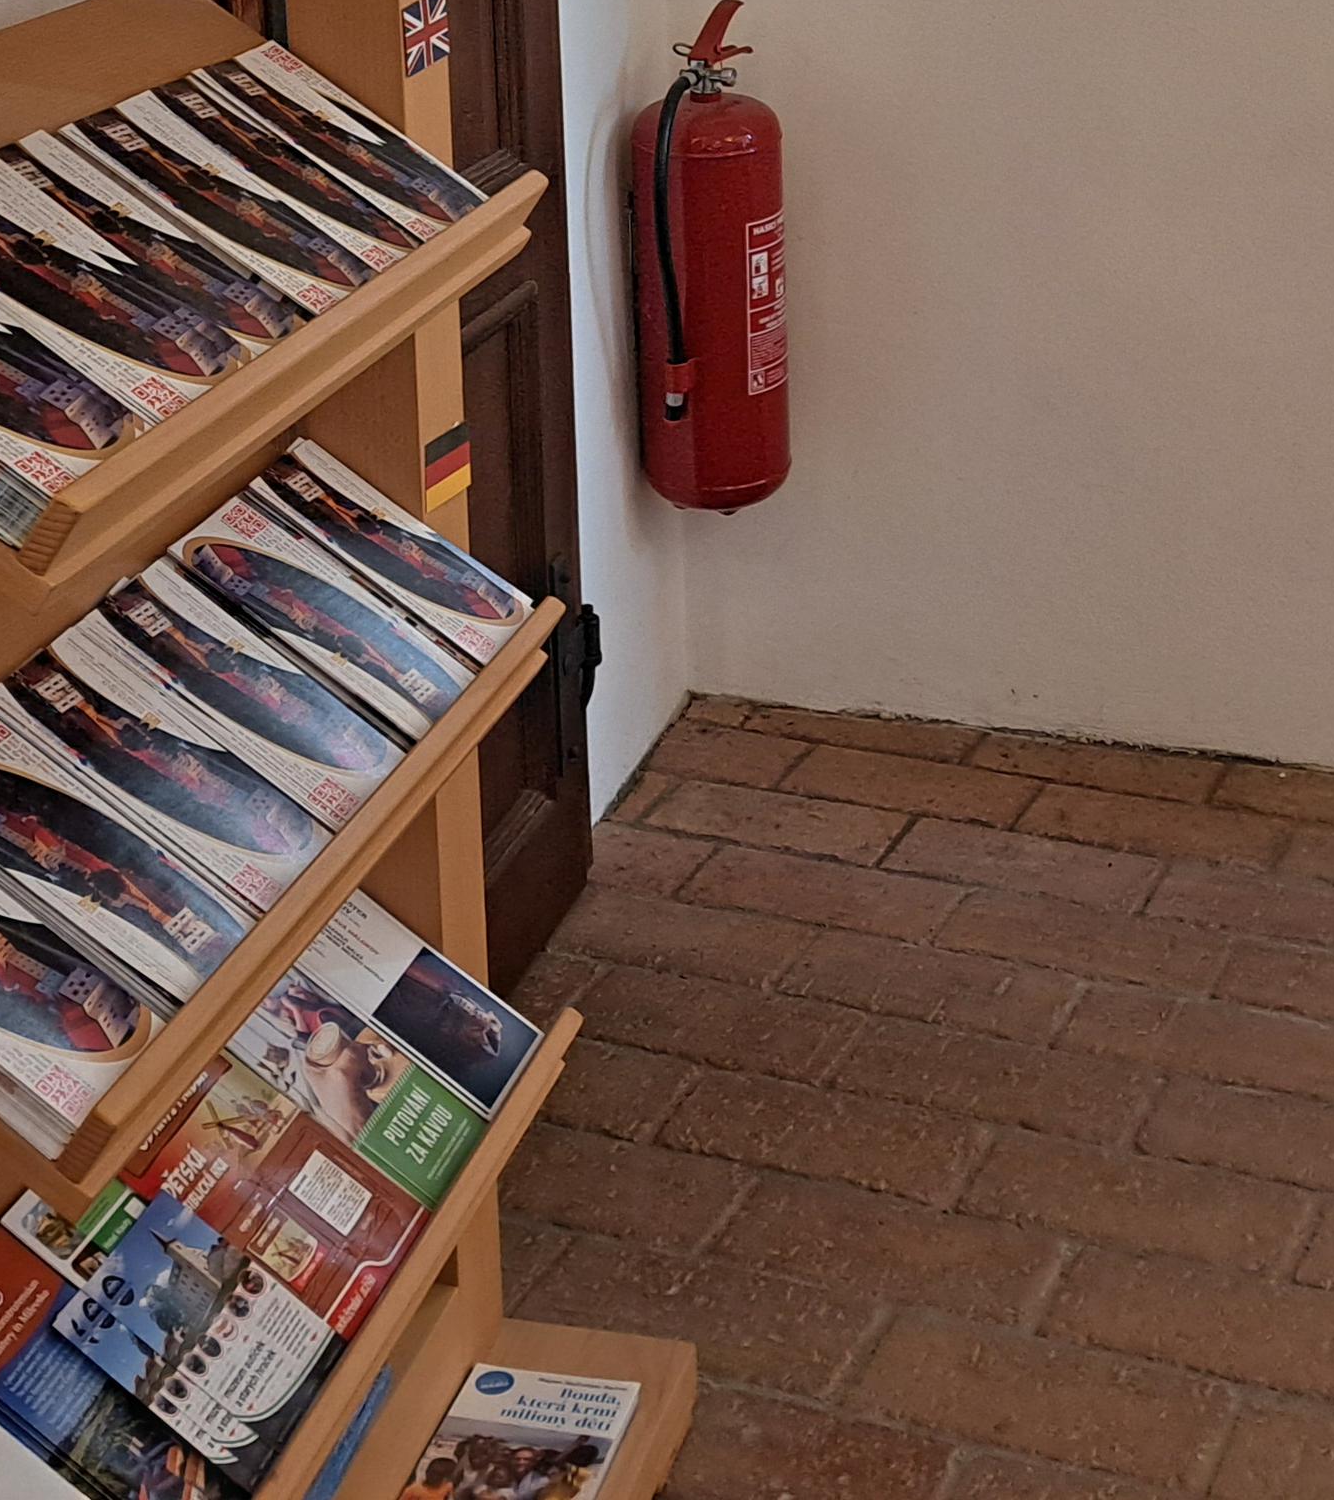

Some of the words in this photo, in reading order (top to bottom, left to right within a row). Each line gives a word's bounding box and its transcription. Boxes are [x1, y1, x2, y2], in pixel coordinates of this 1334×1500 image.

[382, 1083, 432, 1147] PUTOVÁNÍ
[416, 1103, 453, 1149] KÁVOU
[405, 1141, 430, 1165] ZA
[160, 1142, 207, 1199] DĚTSKÁ
[223, 1367, 247, 1399] muzeum
[240, 1373, 262, 1402] starých
[559, 1388, 621, 1406] Bouda,
[500, 1408, 567, 1428] miliony
[574, 1416, 614, 1432] dětí
[517, 1395, 566, 1412] která
[571, 1405, 618, 1418] krmí
